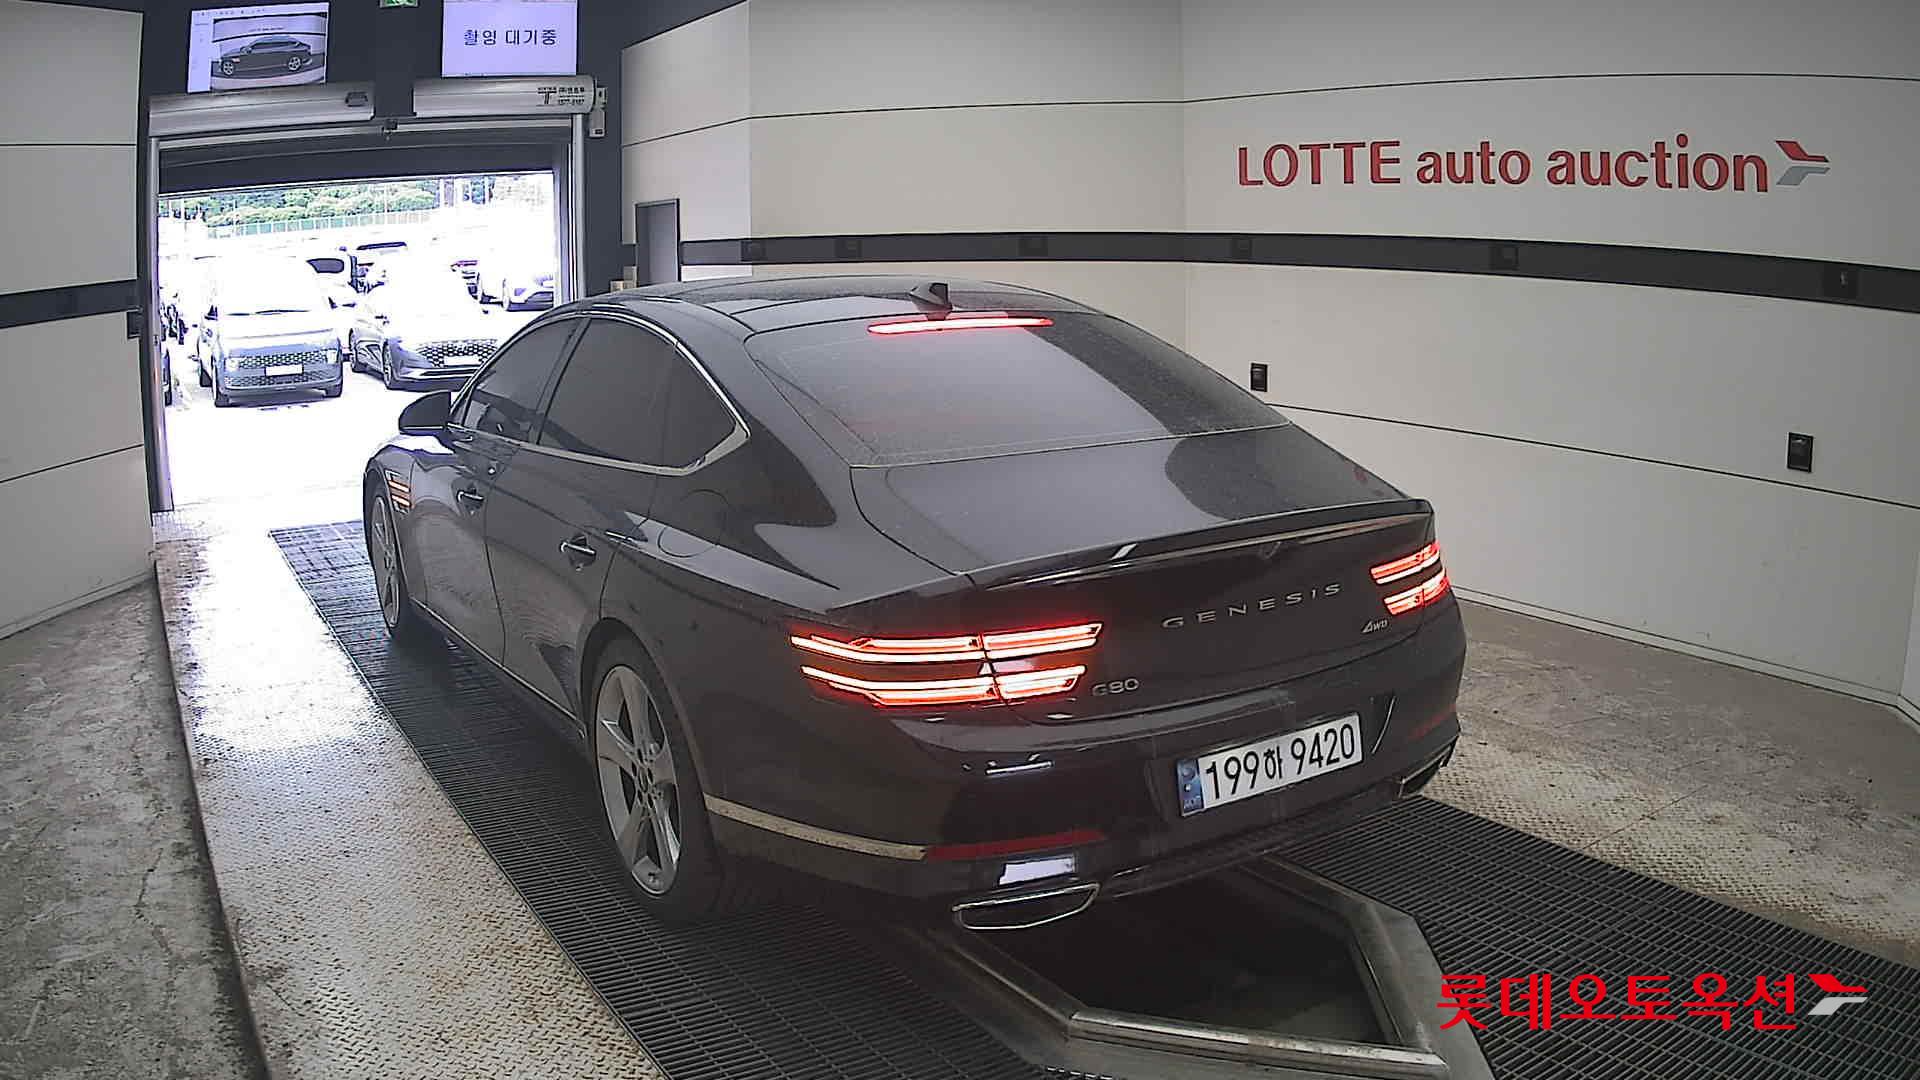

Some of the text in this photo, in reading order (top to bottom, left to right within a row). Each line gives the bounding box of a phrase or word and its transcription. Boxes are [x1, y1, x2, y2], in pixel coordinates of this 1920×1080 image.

[505, 29, 557, 46] 대기중
[1237, 134, 1769, 191] LOTTE auto auction
[1162, 583, 1341, 629] GENESIS
[1092, 678, 1139, 697] G80
[1205, 723, 1355, 800] 199하 9420
